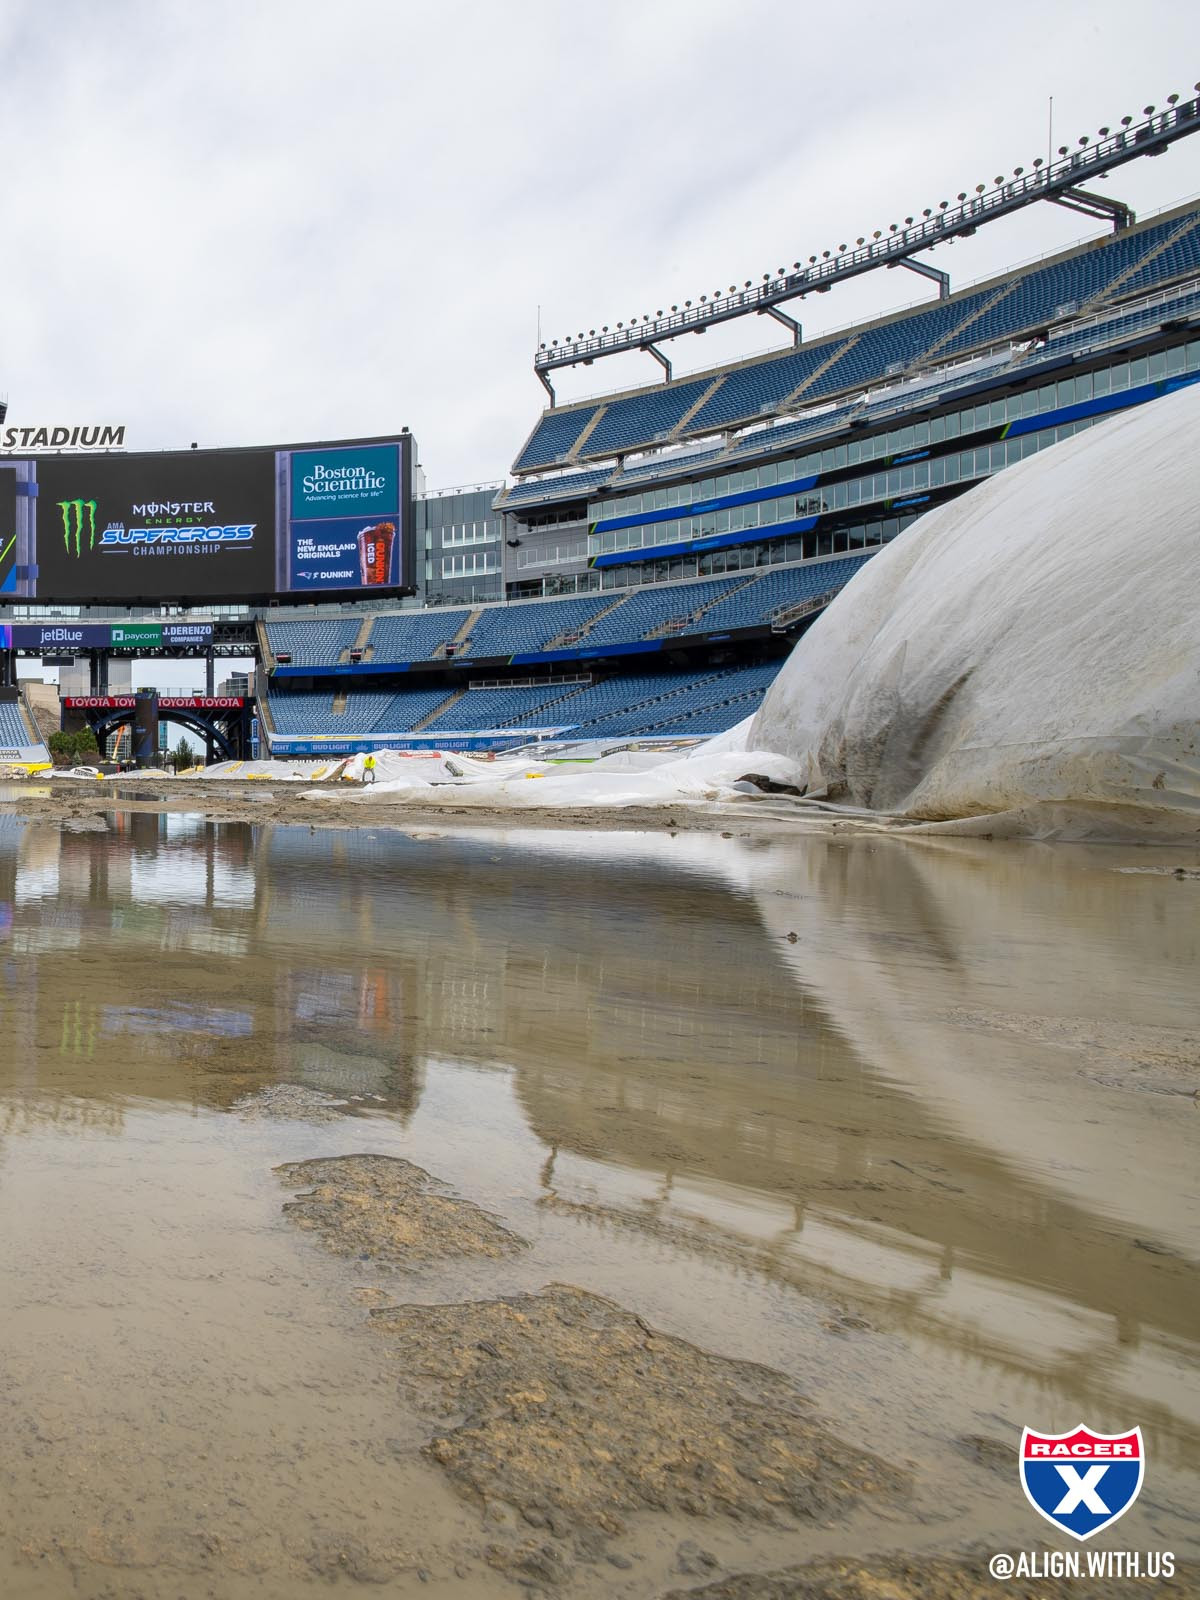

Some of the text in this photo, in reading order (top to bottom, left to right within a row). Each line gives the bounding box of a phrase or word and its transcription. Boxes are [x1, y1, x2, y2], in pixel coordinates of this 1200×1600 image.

[2, 426, 126, 448] STADIUM
[314, 464, 366, 480] Boston
[303, 471, 385, 494] Scientific
[132, 501, 216, 517] MONSTER
[107, 522, 125, 530] AMA
[98, 524, 258, 544] SUPERCROSS
[133, 544, 221, 556] CHAMPIONSHIP
[318, 543, 356, 551] ENGLAND
[297, 551, 341, 559] ORIGINALS
[367, 543, 375, 564] ICED
[320, 571, 354, 579] DUNKIN'
[40, 628, 82, 643] jetBlue
[125, 633, 159, 641] paycom
[162, 626, 212, 636] J.DERENZO
[70, 698, 110, 707] TOYOTA
[158, 698, 196, 707] TOYOTA
[200, 698, 240, 707] TOYOTA
